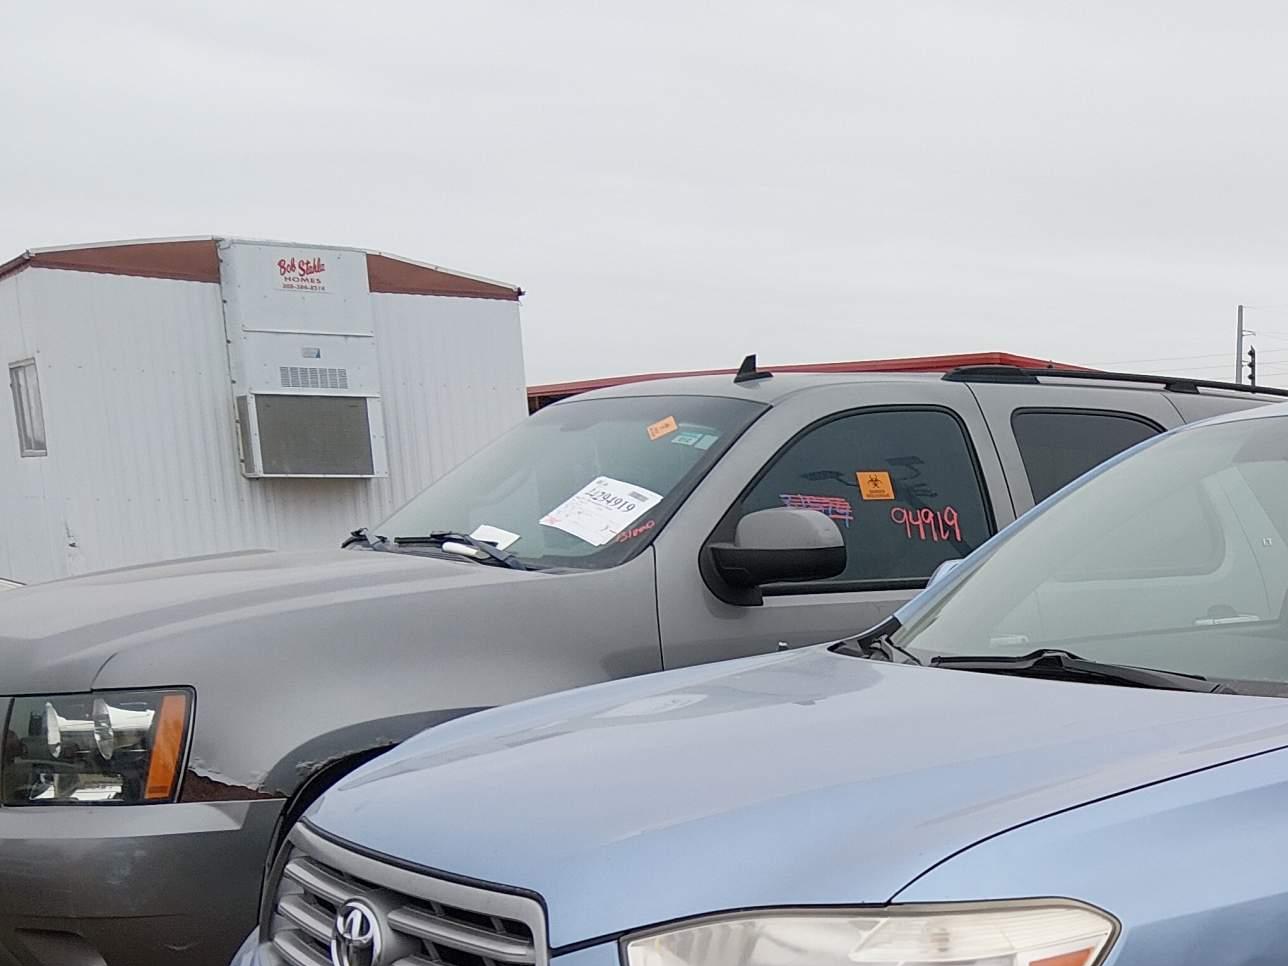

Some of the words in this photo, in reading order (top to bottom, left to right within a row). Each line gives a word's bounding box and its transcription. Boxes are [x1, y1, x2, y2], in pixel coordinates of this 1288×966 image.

[277, 257, 297, 276] Bob
[284, 276, 322, 284] HOMES
[891, 506, 962, 542] 94919
